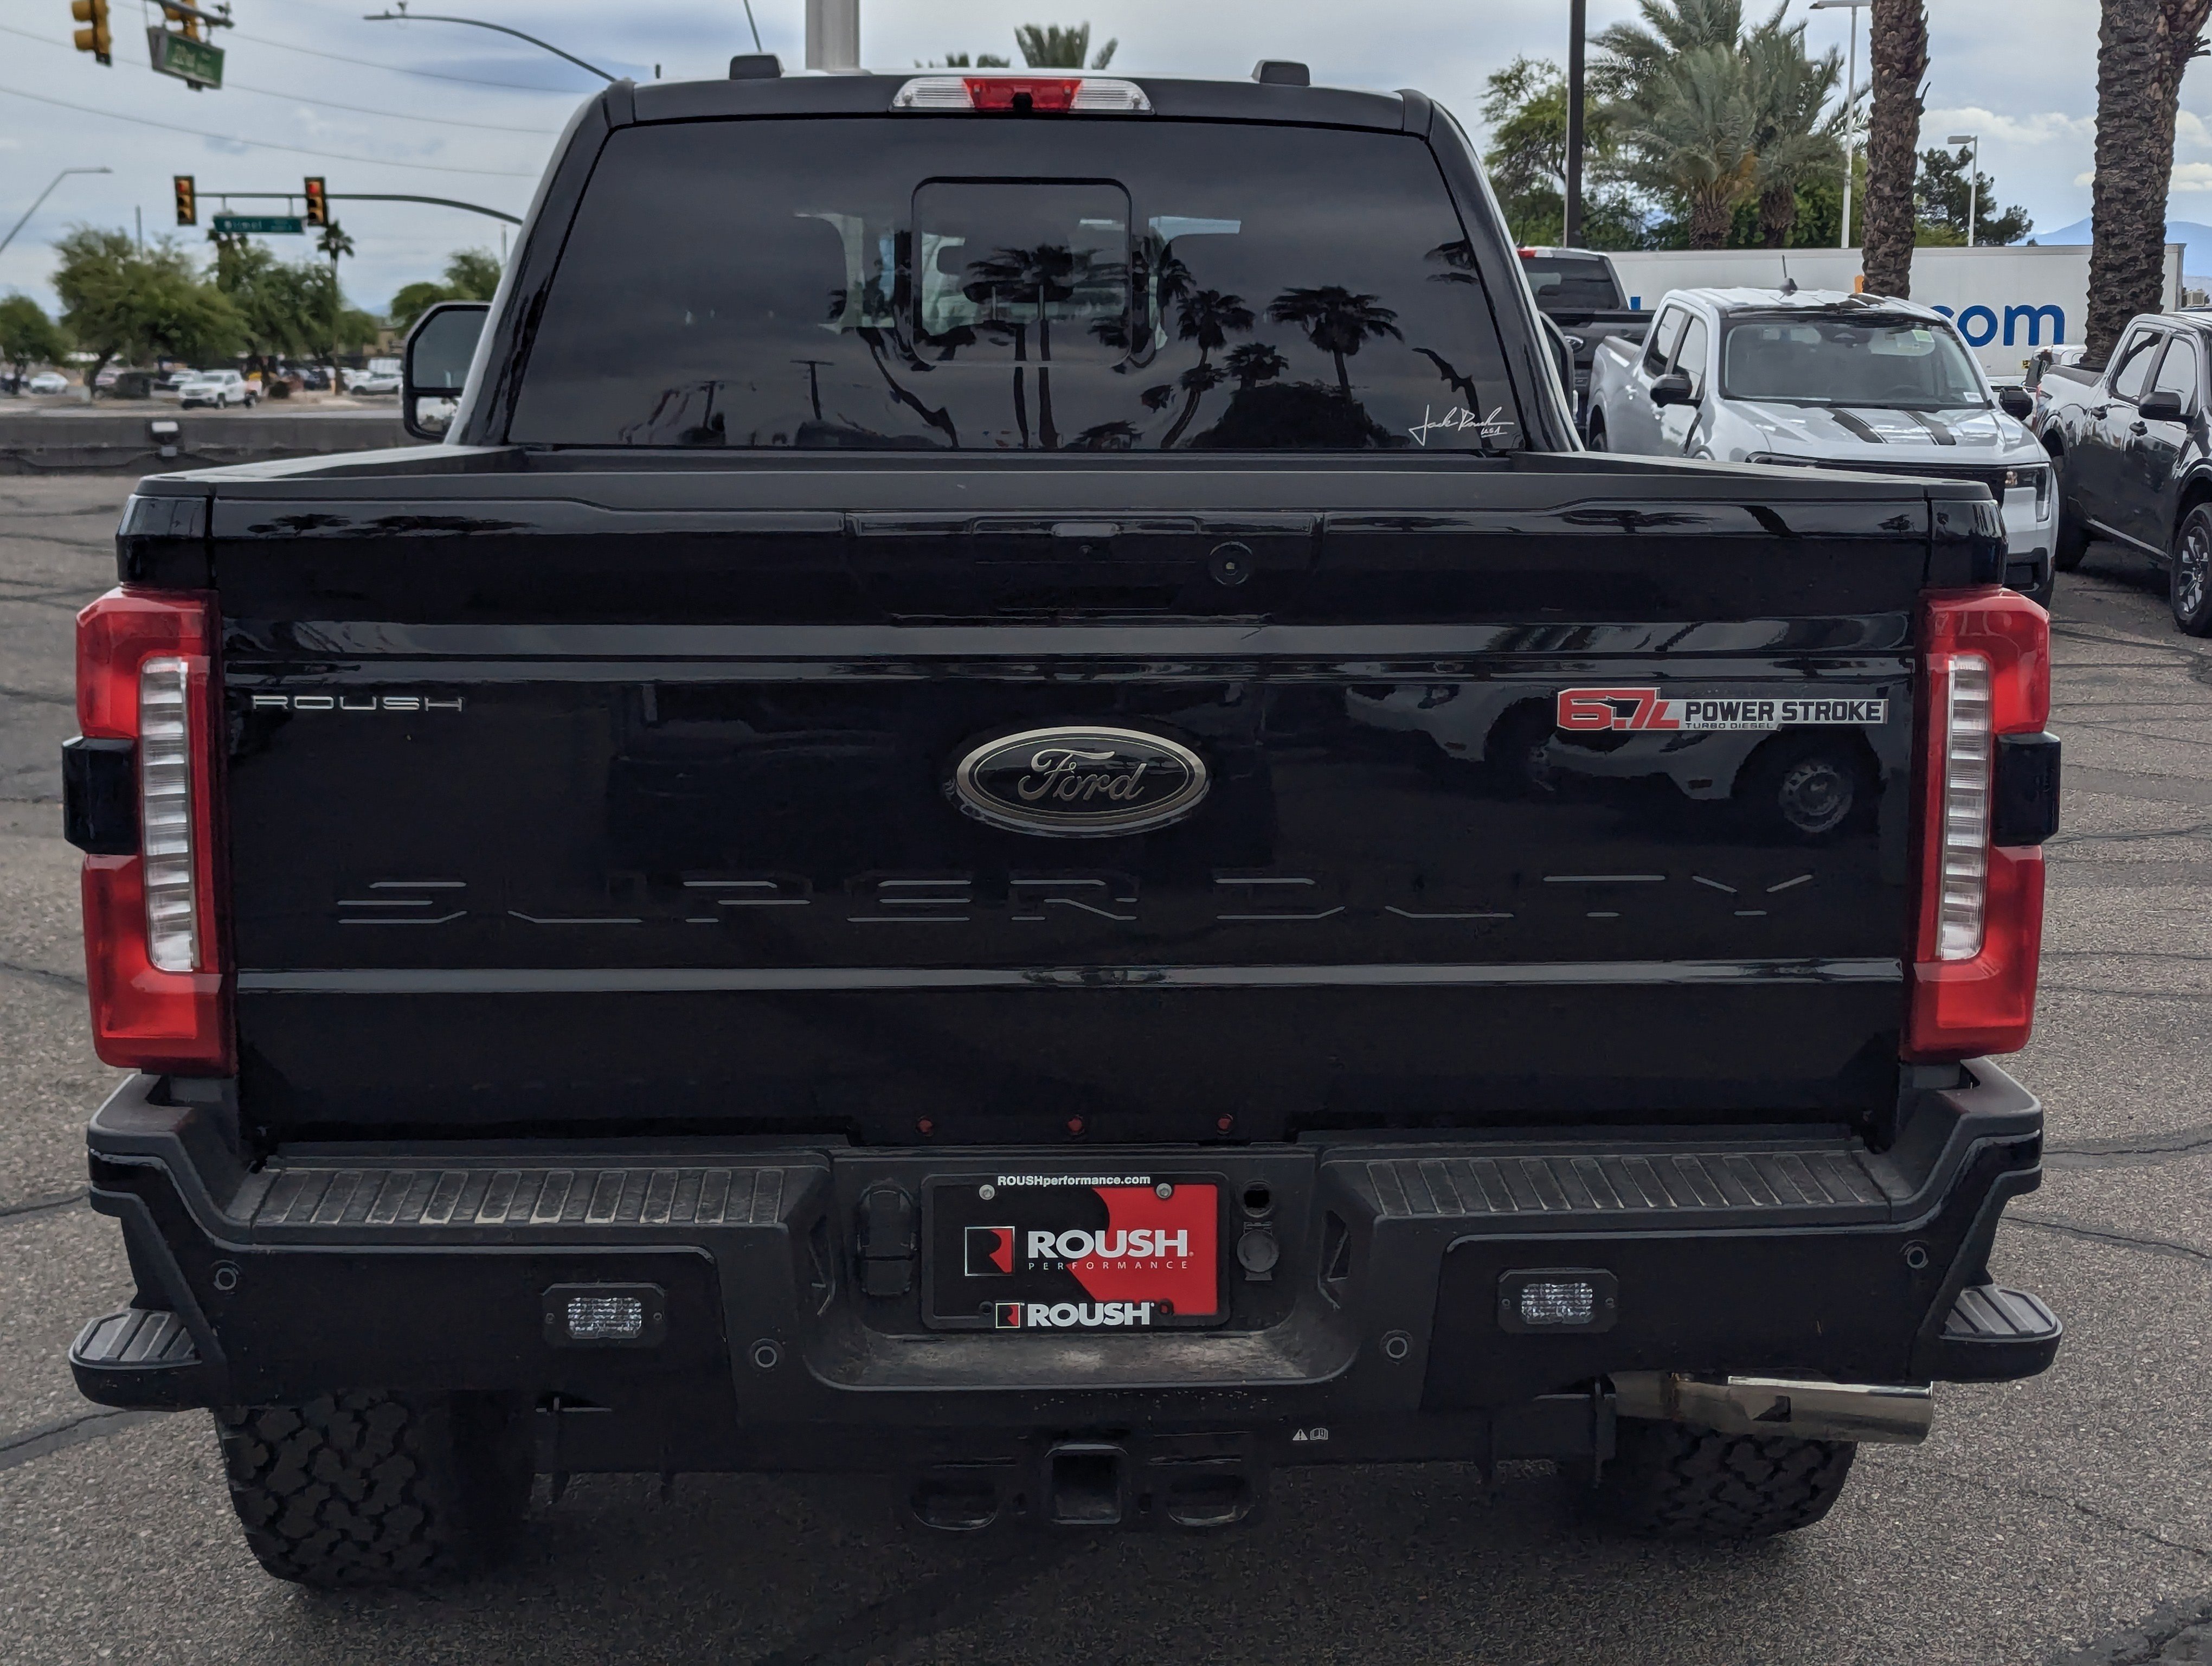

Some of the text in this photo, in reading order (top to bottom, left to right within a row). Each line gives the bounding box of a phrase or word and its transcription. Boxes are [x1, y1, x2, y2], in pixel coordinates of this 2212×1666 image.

[1931, 305, 2065, 347] om
[252, 695, 464, 712] ROUSH
[1558, 688, 1882, 730] 6.7L POWER STROKE
[1018, 748, 1147, 800] Ford
[998, 1175, 1151, 1187] ROUSHperformance.com
[1027, 1229, 1188, 1259] ROUSH
[1028, 1261, 1188, 1270] PERFORMANCE
[1027, 1302, 1150, 1327] ROUSH
